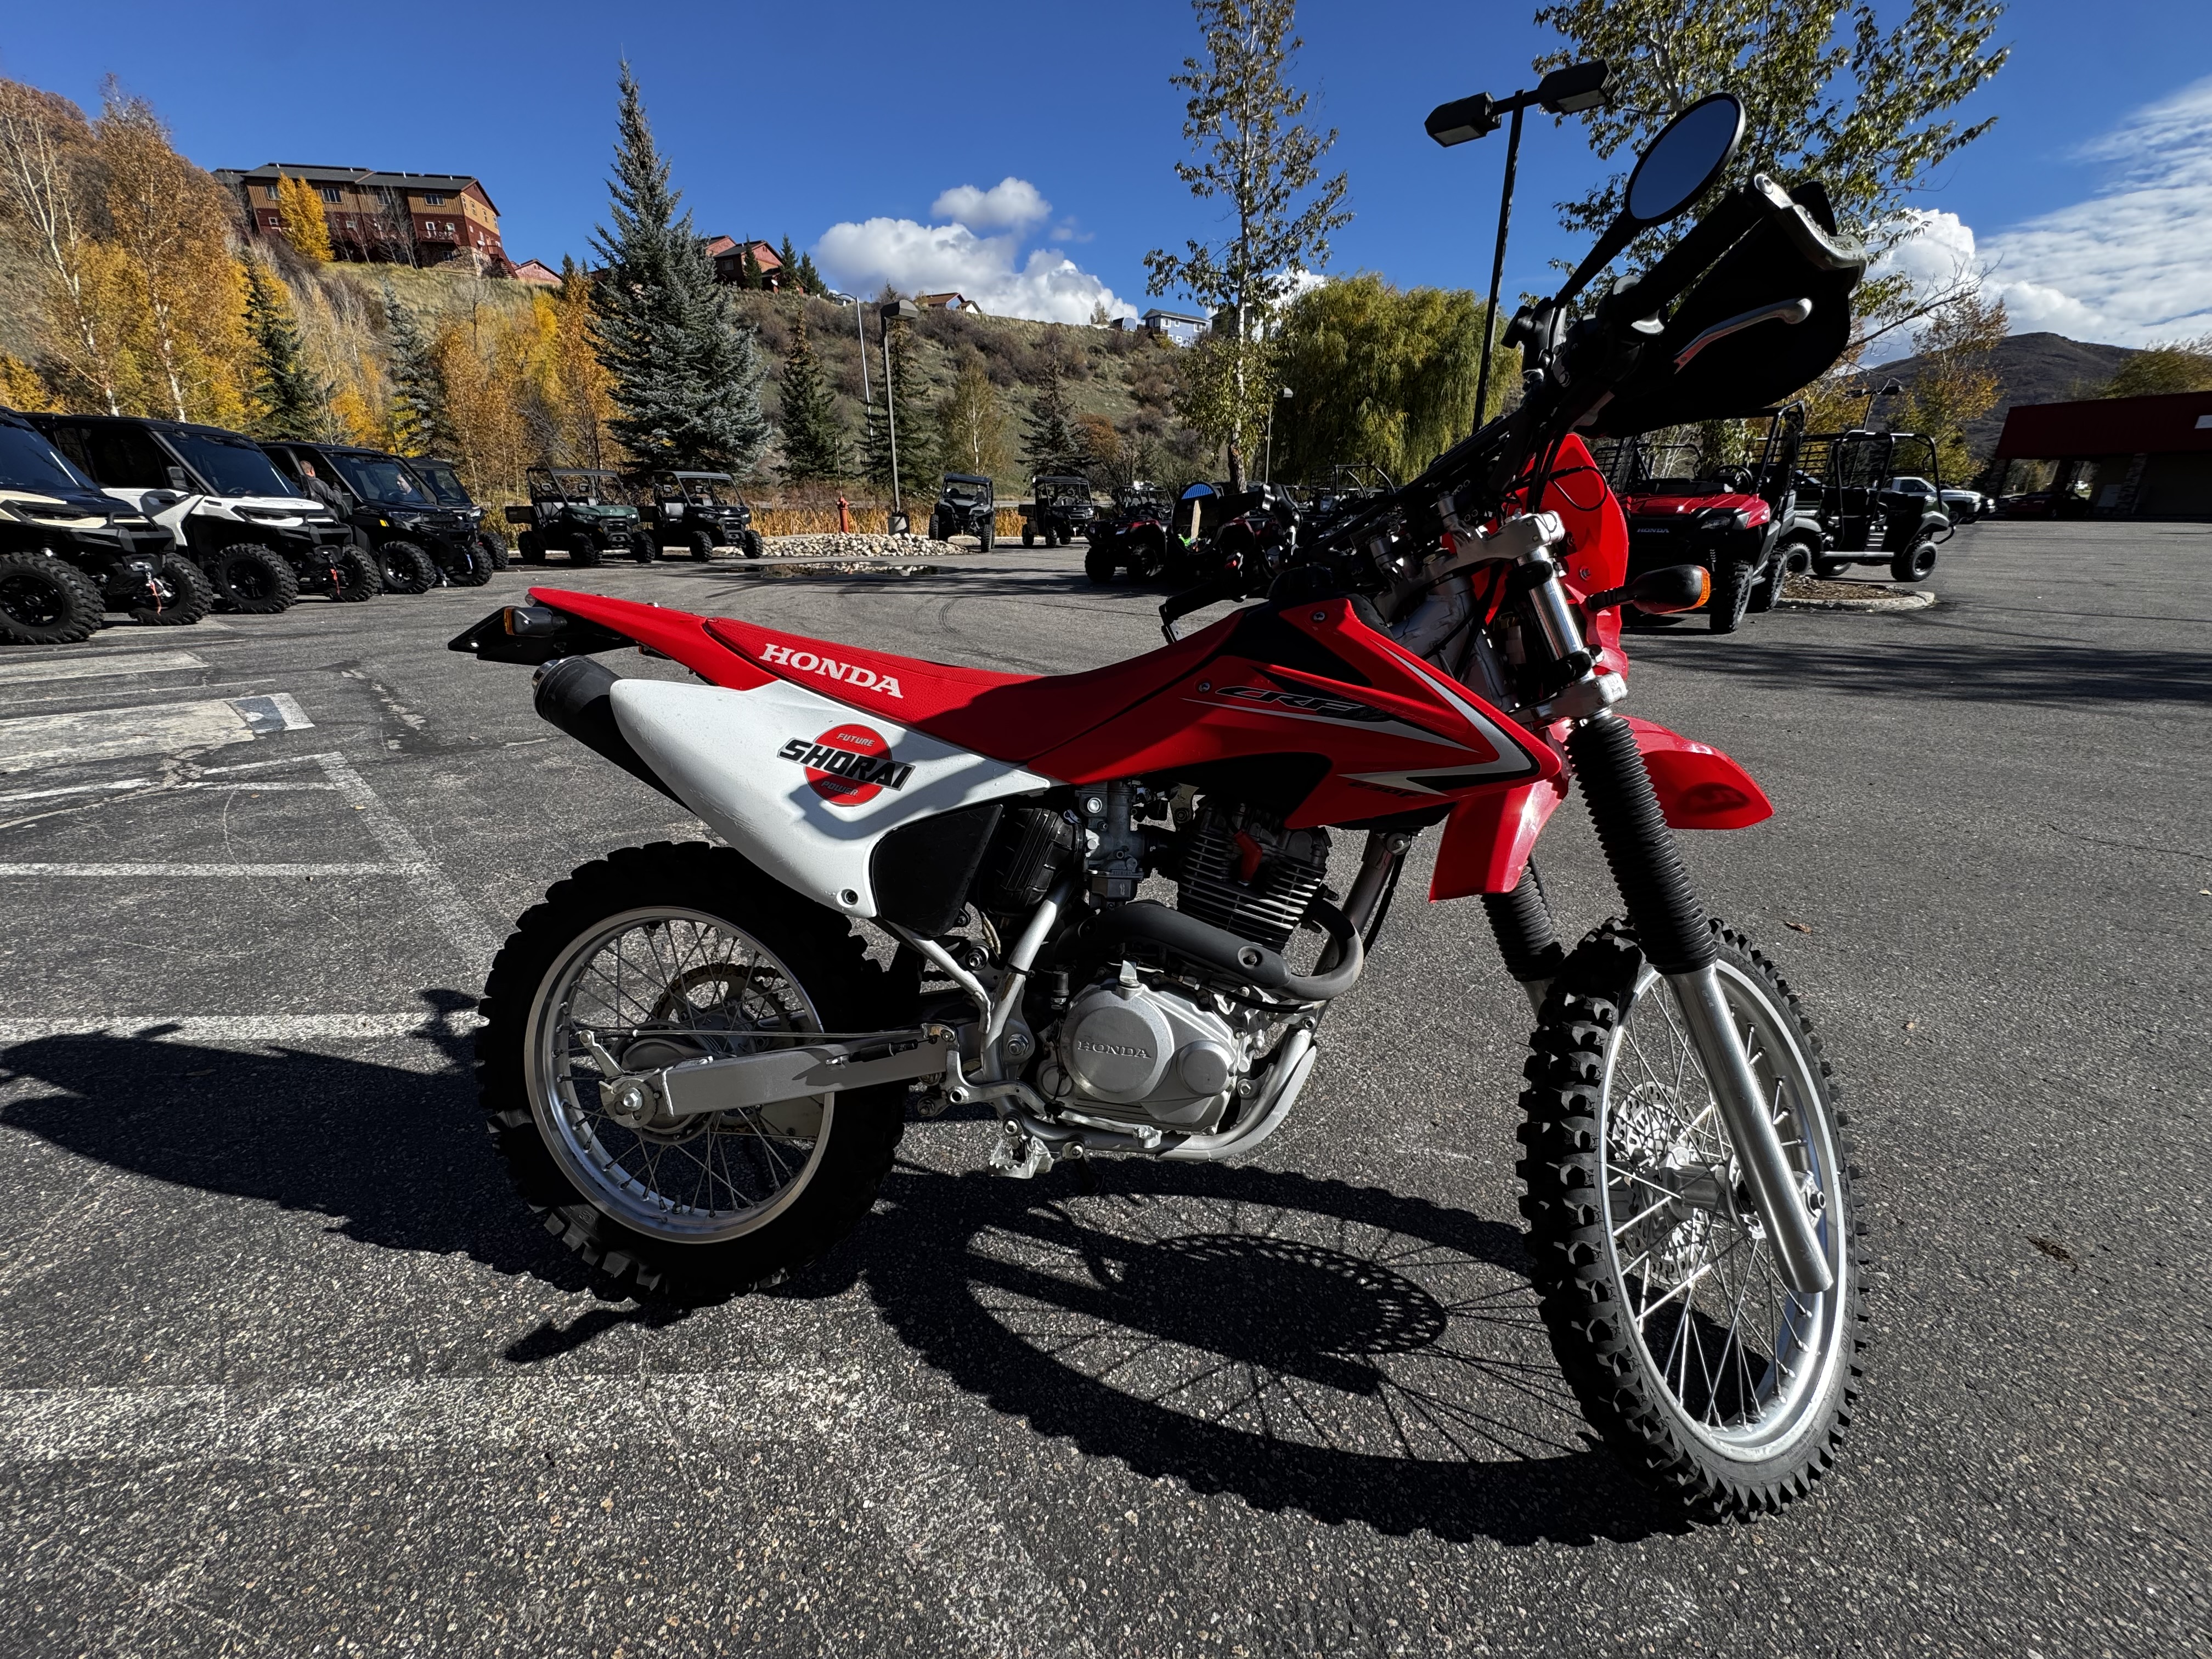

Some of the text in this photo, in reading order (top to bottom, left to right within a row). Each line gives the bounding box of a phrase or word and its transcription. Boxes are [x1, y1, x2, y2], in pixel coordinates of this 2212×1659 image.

[759, 643, 904, 699] HONDA
[1215, 686, 1366, 712] CRF
[836, 732, 876, 747] FUTURE
[779, 738, 913, 789] SHORAI
[821, 781, 860, 797] POWER
[1077, 1040, 1152, 1059] HONDA
